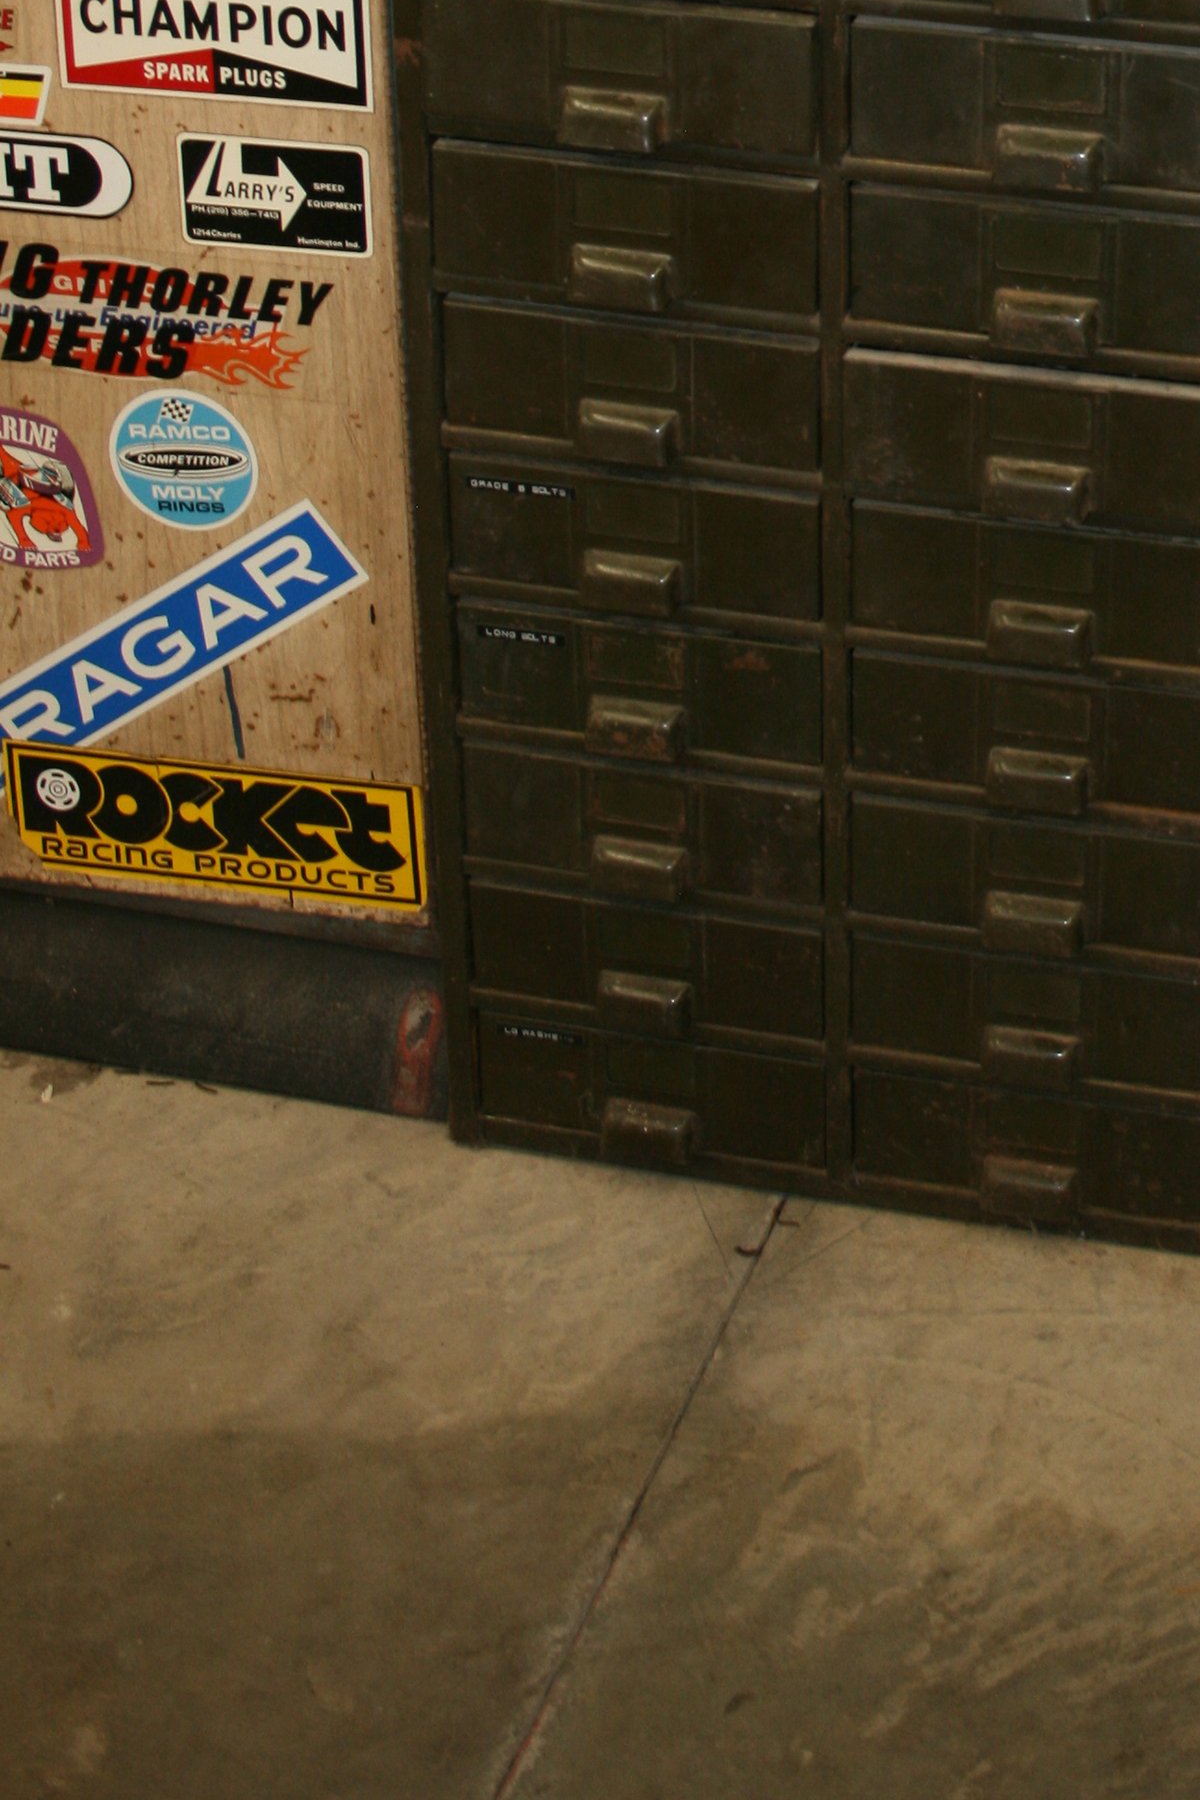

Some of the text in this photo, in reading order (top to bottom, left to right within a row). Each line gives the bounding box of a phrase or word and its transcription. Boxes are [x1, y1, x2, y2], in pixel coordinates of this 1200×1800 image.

[143, 61, 287, 89] SPARK PLUGS
[205, 141, 295, 203] LARRY'S
[313, 182, 345, 193] SPEED
[306, 199, 363, 212] EQUIPMENT
[297, 236, 343, 248] Huntington
[79, 260, 334, 326] THORLEY
[0, 414, 59, 453] RINE
[128, 422, 231, 441] RAMCO
[137, 453, 230, 466] COMPETITION
[151, 484, 225, 500] MOLY
[470, 478, 509, 491] GRADE
[158, 500, 226, 514] RINGS
[25, 550, 81, 567] PARTS
[485, 627, 516, 639] LONG
[194, 854, 396, 895] PRODUCTS
